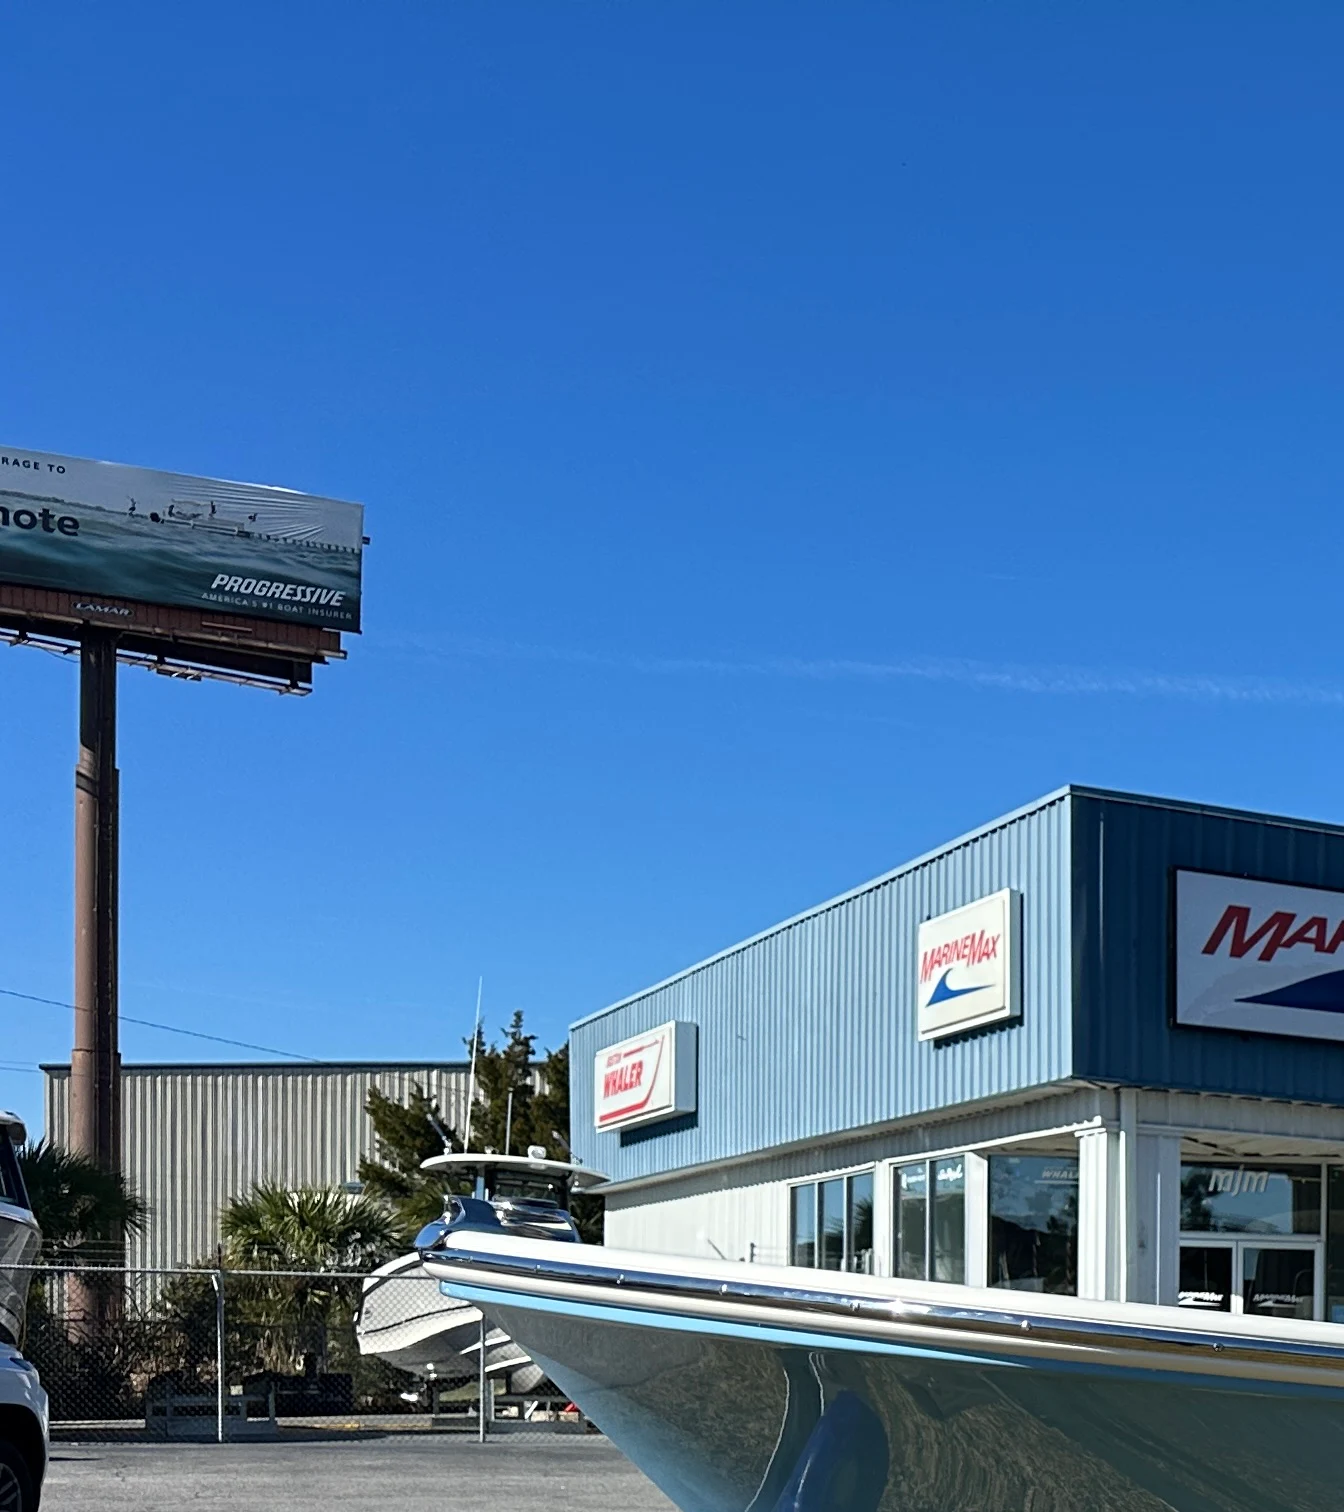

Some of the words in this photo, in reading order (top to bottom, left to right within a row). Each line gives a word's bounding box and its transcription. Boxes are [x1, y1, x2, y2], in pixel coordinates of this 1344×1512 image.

[47, 463, 66, 474] TO
[210, 573, 346, 607] PROGRESSIVE
[75, 602, 131, 617] LAMAR
[201, 592, 257, 608] AMERICAS
[277, 603, 304, 614] BOAT
[307, 607, 353, 620] INSURER
[603, 1060, 643, 1099] WHALER
[1208, 1164, 1270, 1197] mjm
